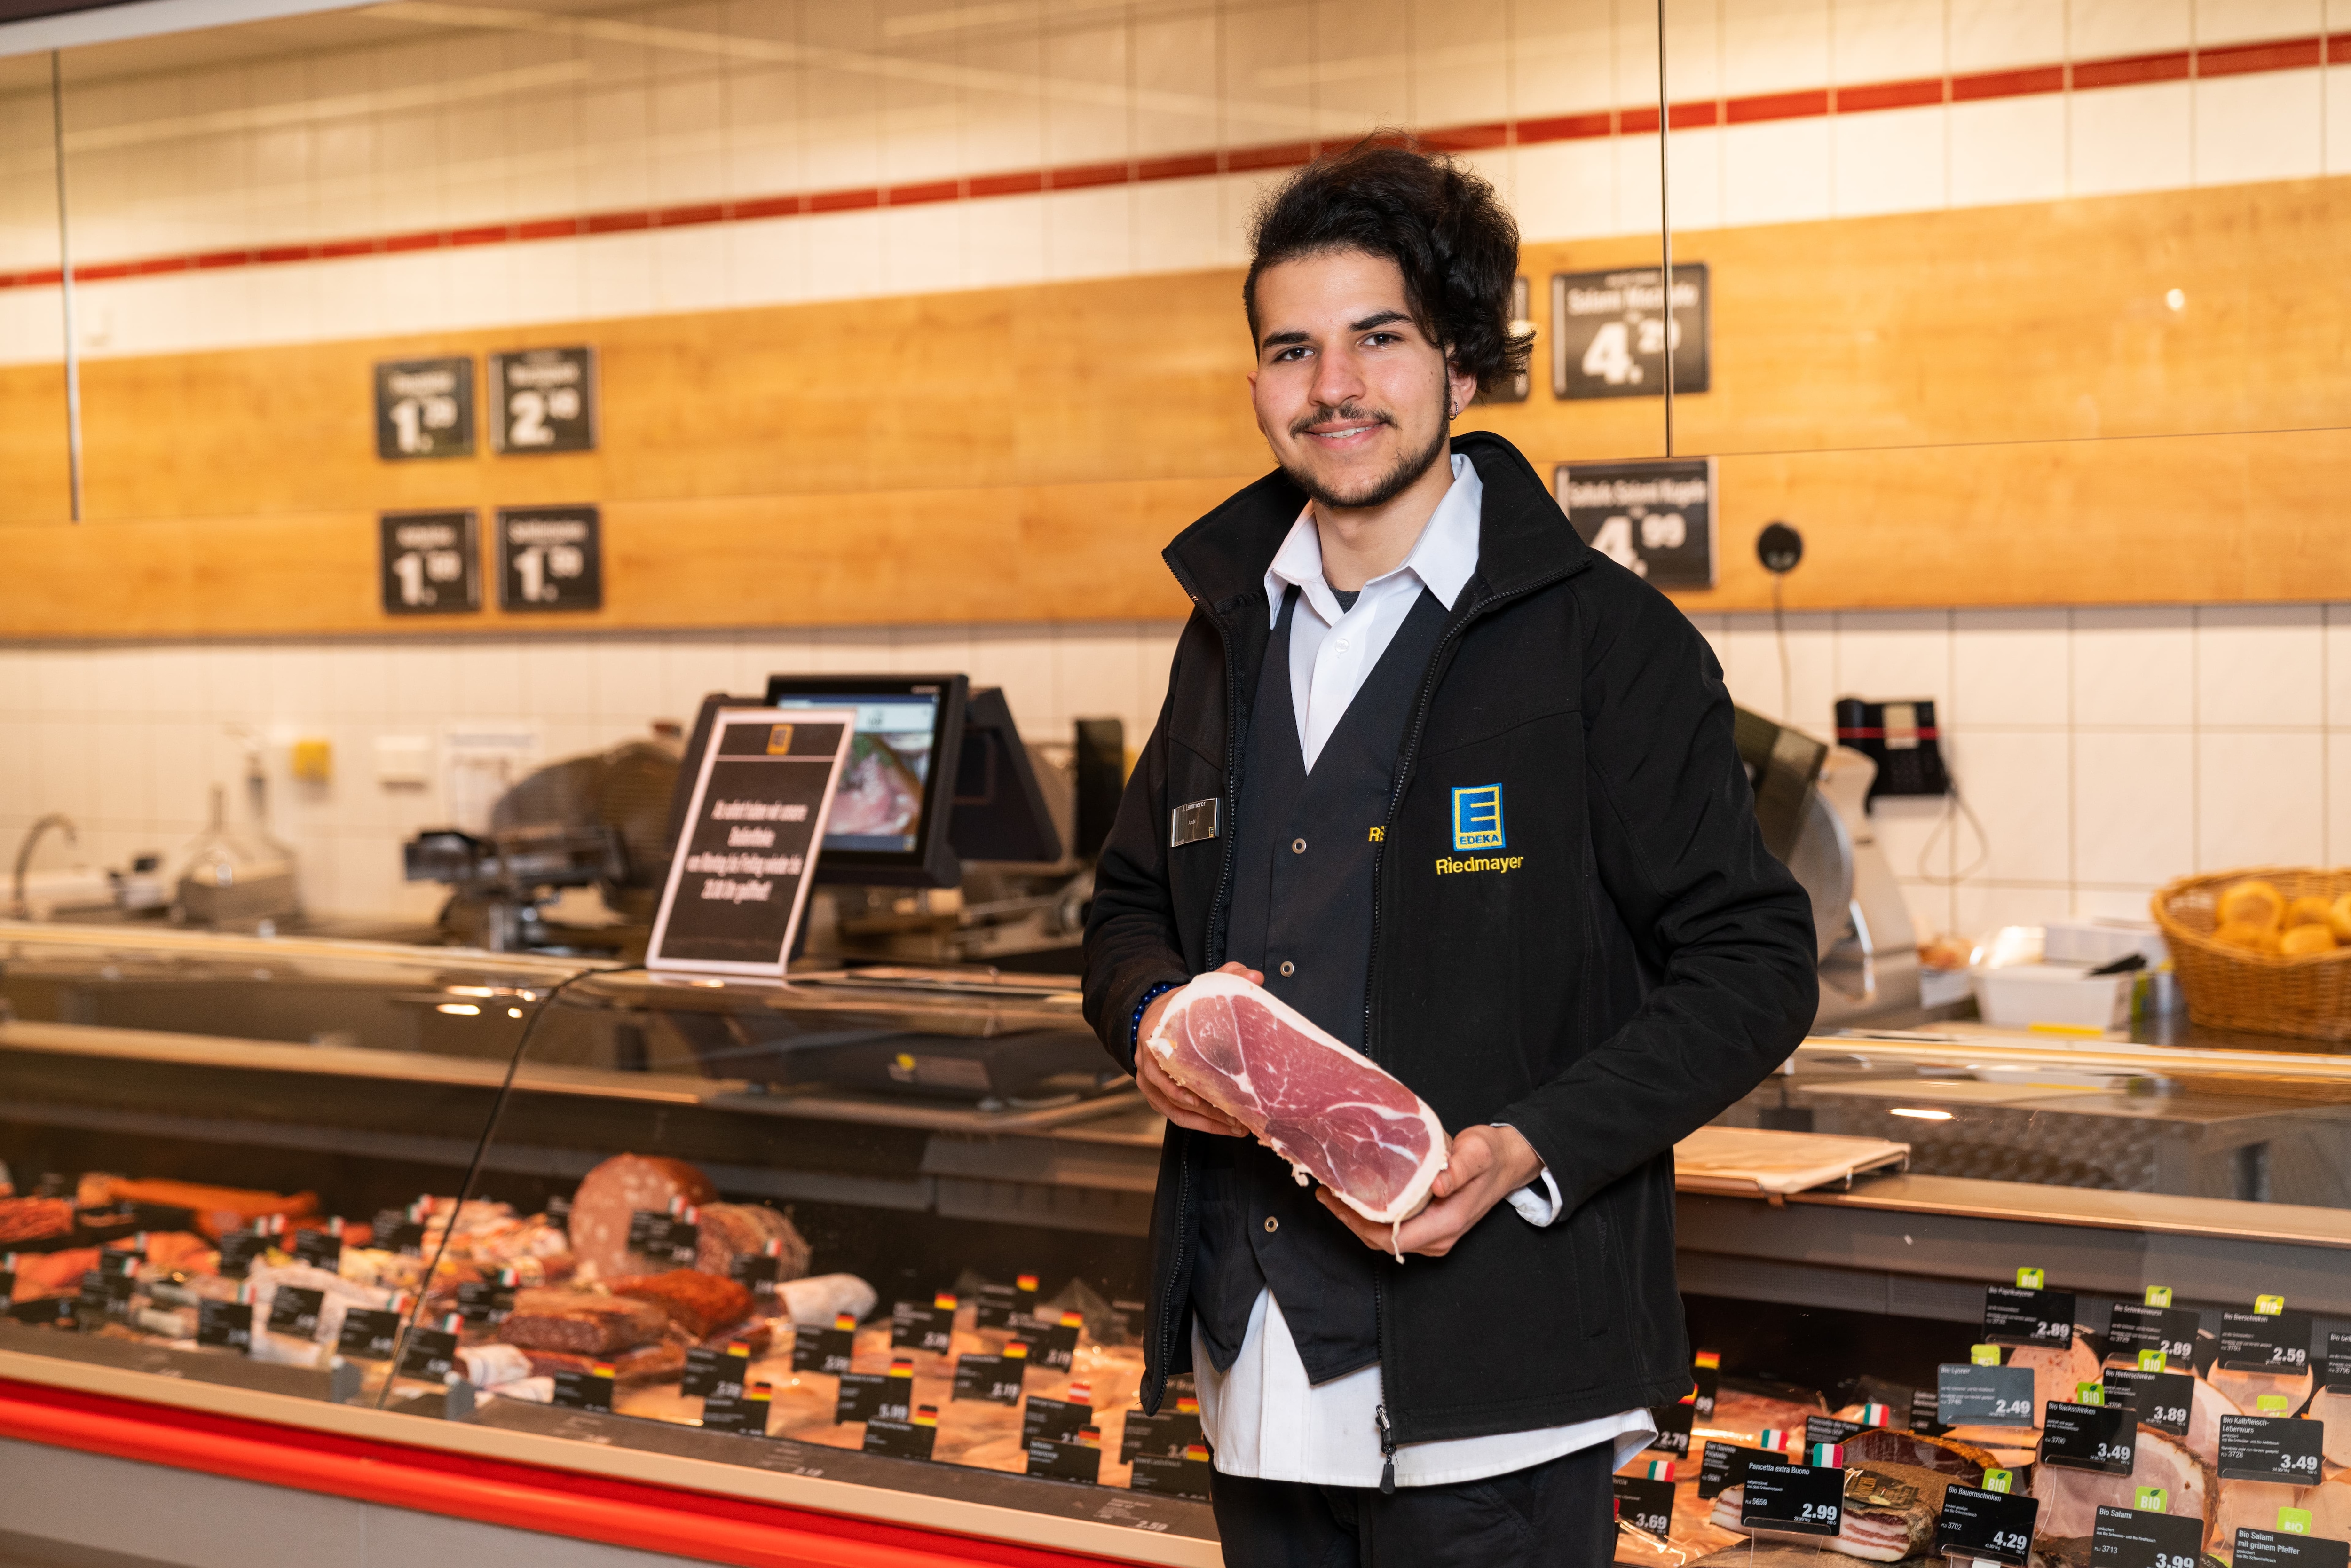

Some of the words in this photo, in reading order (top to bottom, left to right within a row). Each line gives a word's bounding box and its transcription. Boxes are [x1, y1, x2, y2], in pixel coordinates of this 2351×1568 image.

[1186, 802, 1206, 811] Lemmerer
[1460, 835, 1499, 845] EDEKA
[1436, 857, 1523, 875] Riedmayer
[2150, 1293, 2167, 1306] BIO
[2260, 1301, 2277, 1313] BIO
[2233, 1313, 2268, 1323] Bierschinken
[2037, 1321, 2070, 1337] 2.89
[2160, 1340, 2192, 1357] 2.89
[2273, 1347, 2306, 1363] 2.59
[2143, 1358, 2161, 1371] BIO
[2115, 1371, 2155, 1381] Hinterschinken
[2083, 1390, 2099, 1404] BIO
[1996, 1399, 2031, 1414] 2.49
[2059, 1403, 2096, 1415] Backschinken
[2154, 1406, 2187, 1422] 3.89
[2234, 1417, 2270, 1426] Kalbfleisch-
[2223, 1425, 2254, 1434] Leberwurs
[1661, 1431, 1688, 1447] 2.79
[1717, 1443, 1736, 1454] Daniele
[2098, 1442, 2130, 1460] 3.49
[1749, 1462, 1774, 1472] Pancetta
[1791, 1466, 1810, 1475] Buono
[2280, 1454, 2318, 1470] 3.49
[1988, 1478, 2006, 1492] BIO
[1958, 1488, 2002, 1502] Bauernschinken
[2141, 1496, 2161, 1510] BIO
[1802, 1503, 1837, 1521] 2.99
[2111, 1510, 2132, 1519] Salami
[1636, 1513, 1668, 1530] 3.69
[1948, 1522, 1962, 1531] 3702
[2284, 1522, 2303, 1533] BIO
[1993, 1531, 2027, 1550] 4.29
[2251, 1532, 2273, 1542] Salami
[2102, 1545, 2118, 1554] 3713
[2250, 1542, 2276, 1552] grünem
[2277, 1545, 2300, 1555] Pfeffer
[2156, 1553, 2194, 1568] 3.99
